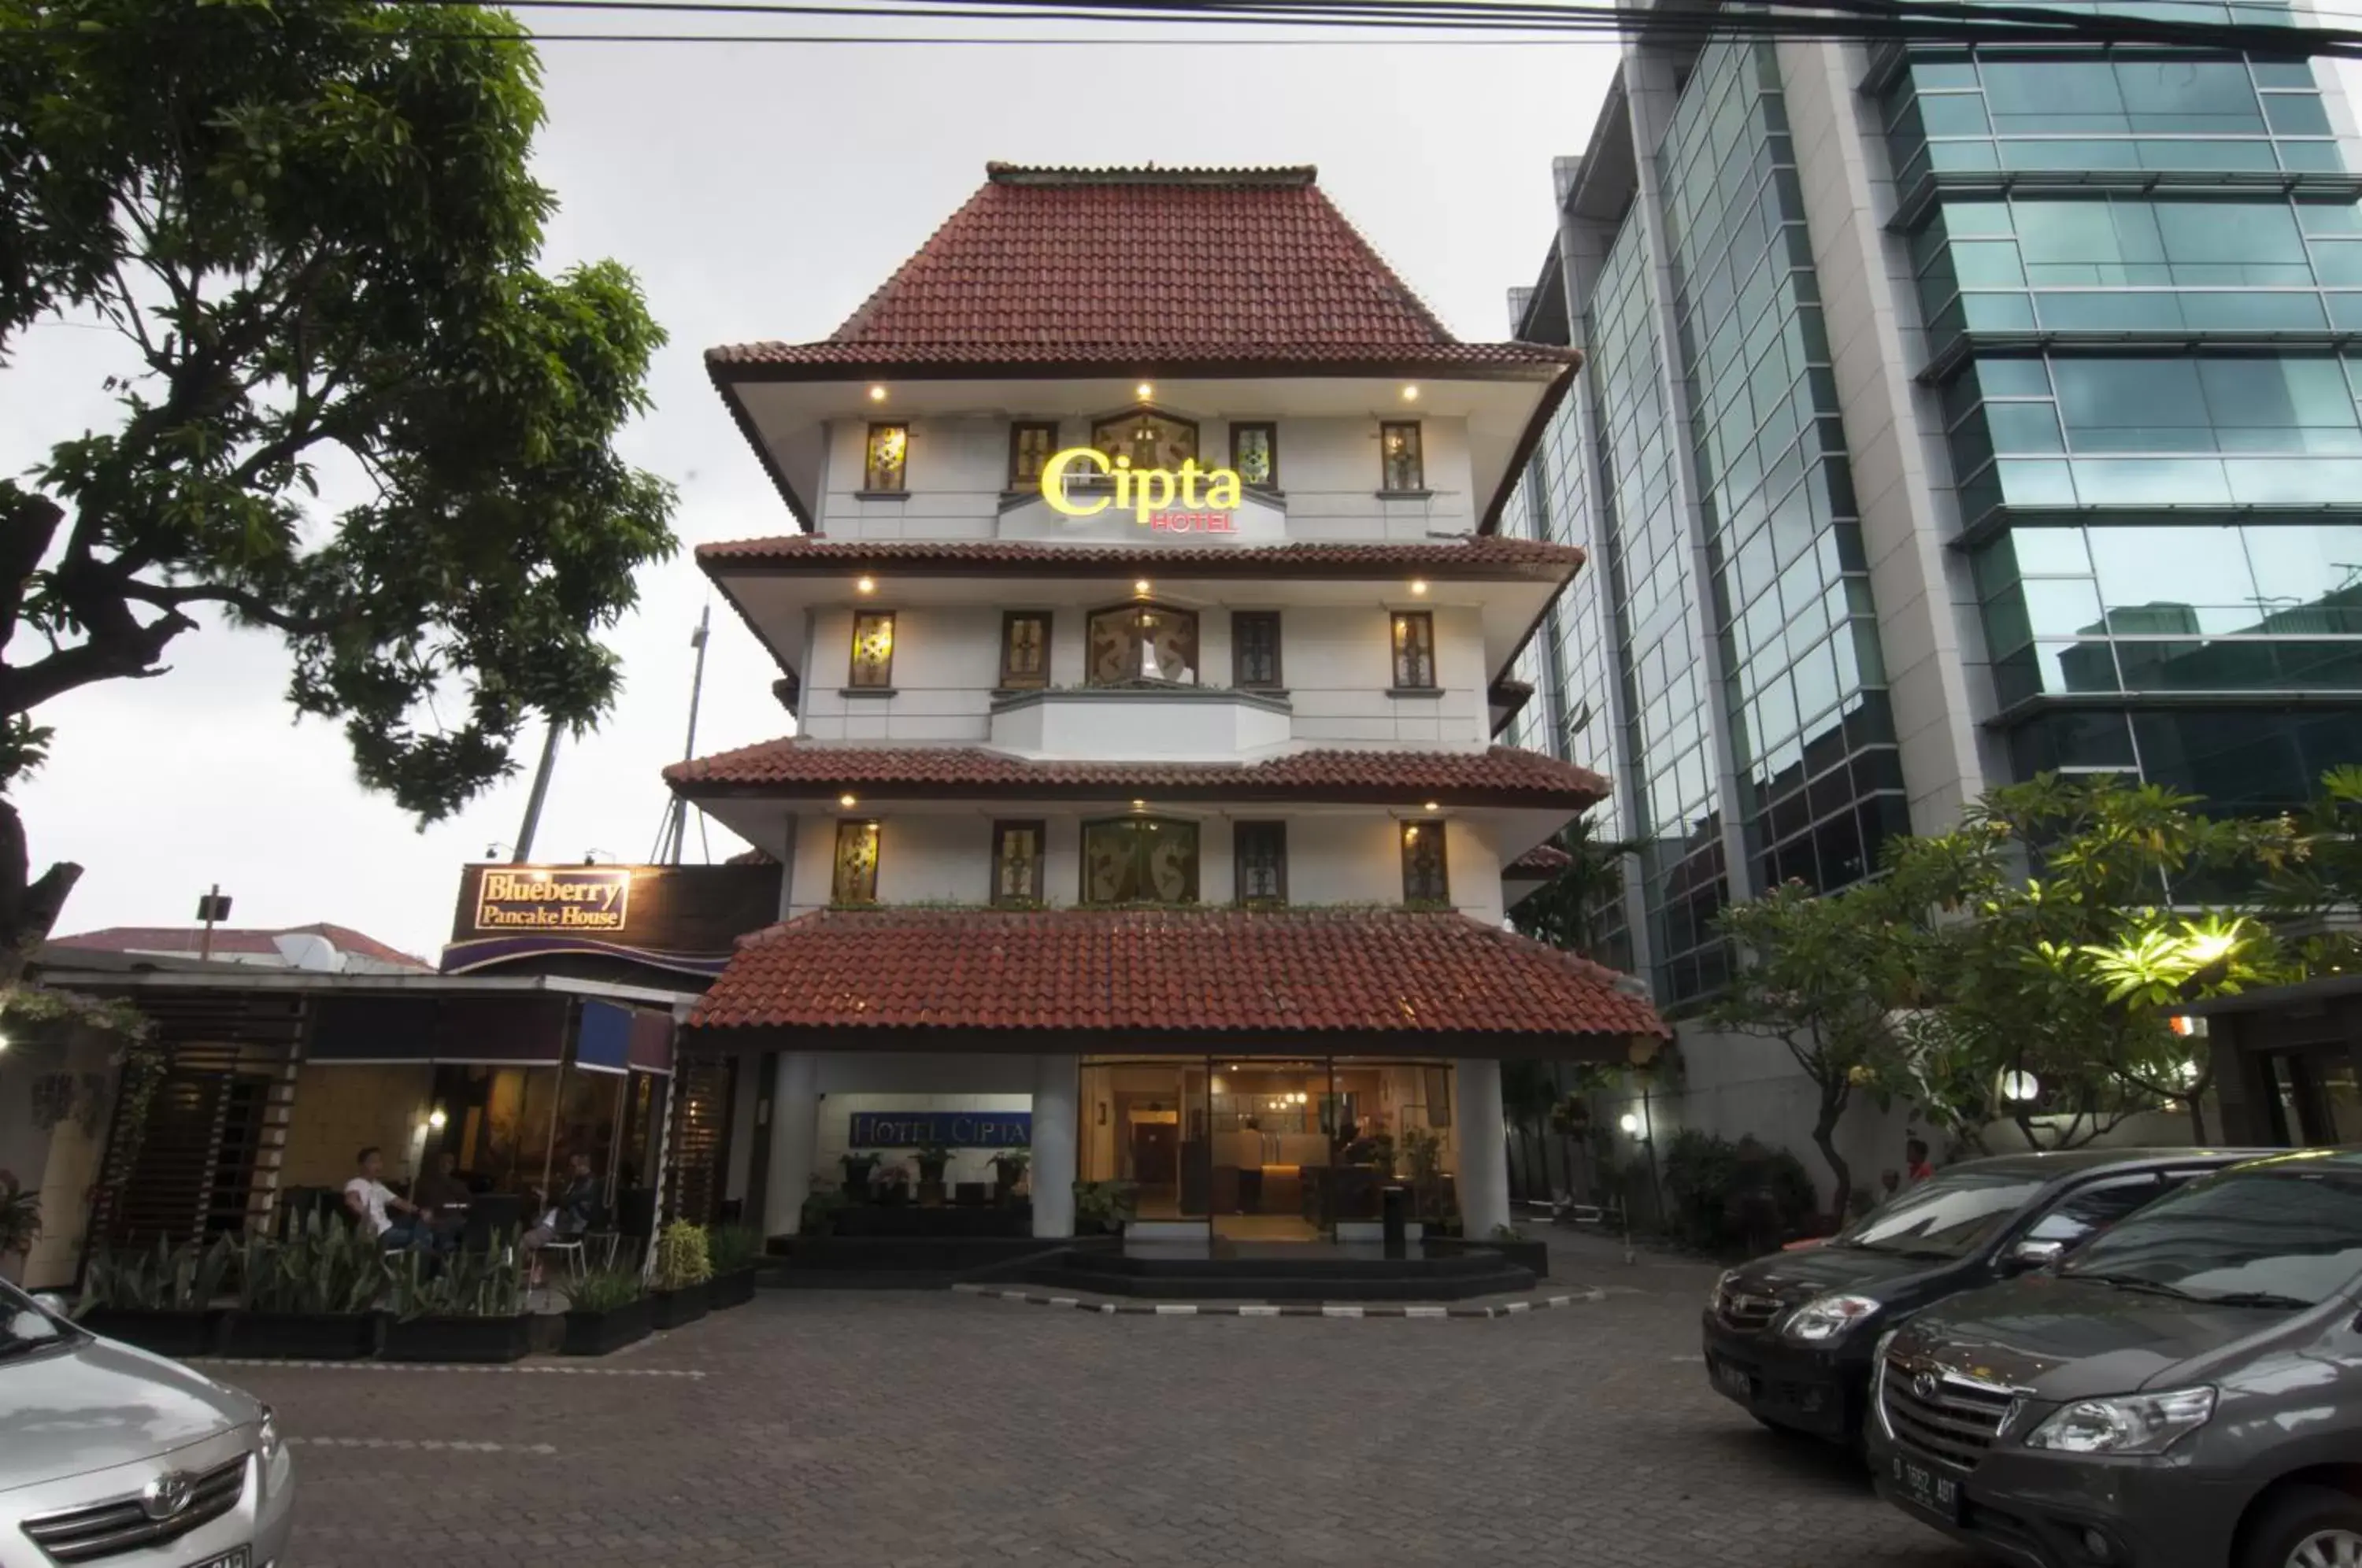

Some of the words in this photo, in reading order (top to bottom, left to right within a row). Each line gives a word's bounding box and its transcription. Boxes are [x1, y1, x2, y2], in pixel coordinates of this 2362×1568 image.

[1041, 446, 1242, 523] Cipta
[1150, 512, 1239, 533] HOTEL
[485, 874, 624, 912] Blueberry
[482, 905, 558, 925] Pancake
[561, 905, 619, 926] House
[951, 1115, 1027, 1143] CIPTA
